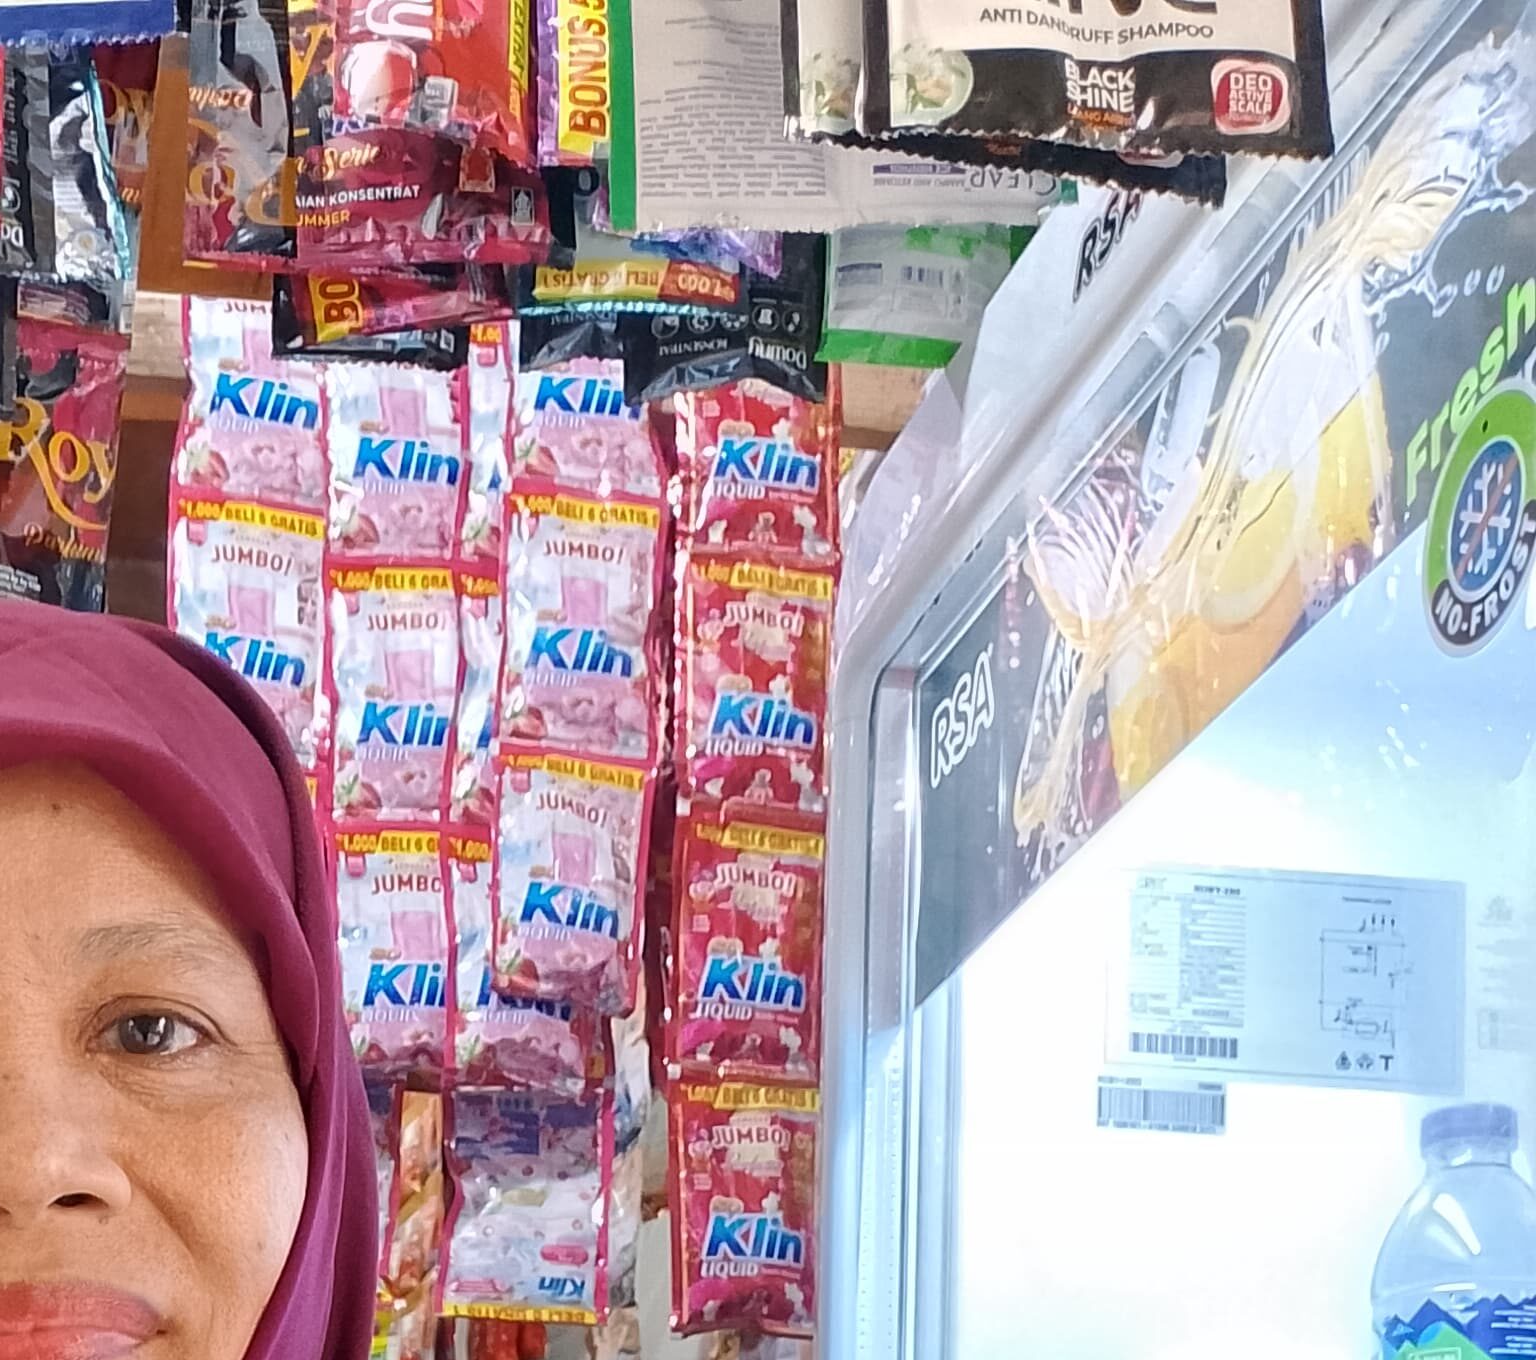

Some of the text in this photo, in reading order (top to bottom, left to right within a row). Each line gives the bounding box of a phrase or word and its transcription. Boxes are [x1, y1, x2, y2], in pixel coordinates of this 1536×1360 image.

[980, 8, 1214, 44] ANTI DANDRUFF SHAMPOO
[569, 16, 609, 137] BONUS
[1065, 57, 1135, 89] BLACK
[1230, 72, 1272, 91] DEO
[1066, 83, 1134, 114] SHINE
[329, 185, 420, 206] KONSENTRAT
[749, 337, 808, 369] Downy
[210, 373, 320, 430] Klin
[352, 436, 461, 486] Klin
[712, 437, 820, 490] Klin
[204, 633, 306, 687] Klin
[525, 626, 634, 678] Klin
[710, 692, 815, 745] Klin
[928, 649, 996, 791] RSA
[520, 881, 620, 939] Klin
[701, 957, 807, 1008] Klin
[706, 1214, 805, 1263] Klin
[536, 1275, 586, 1300] Klin
